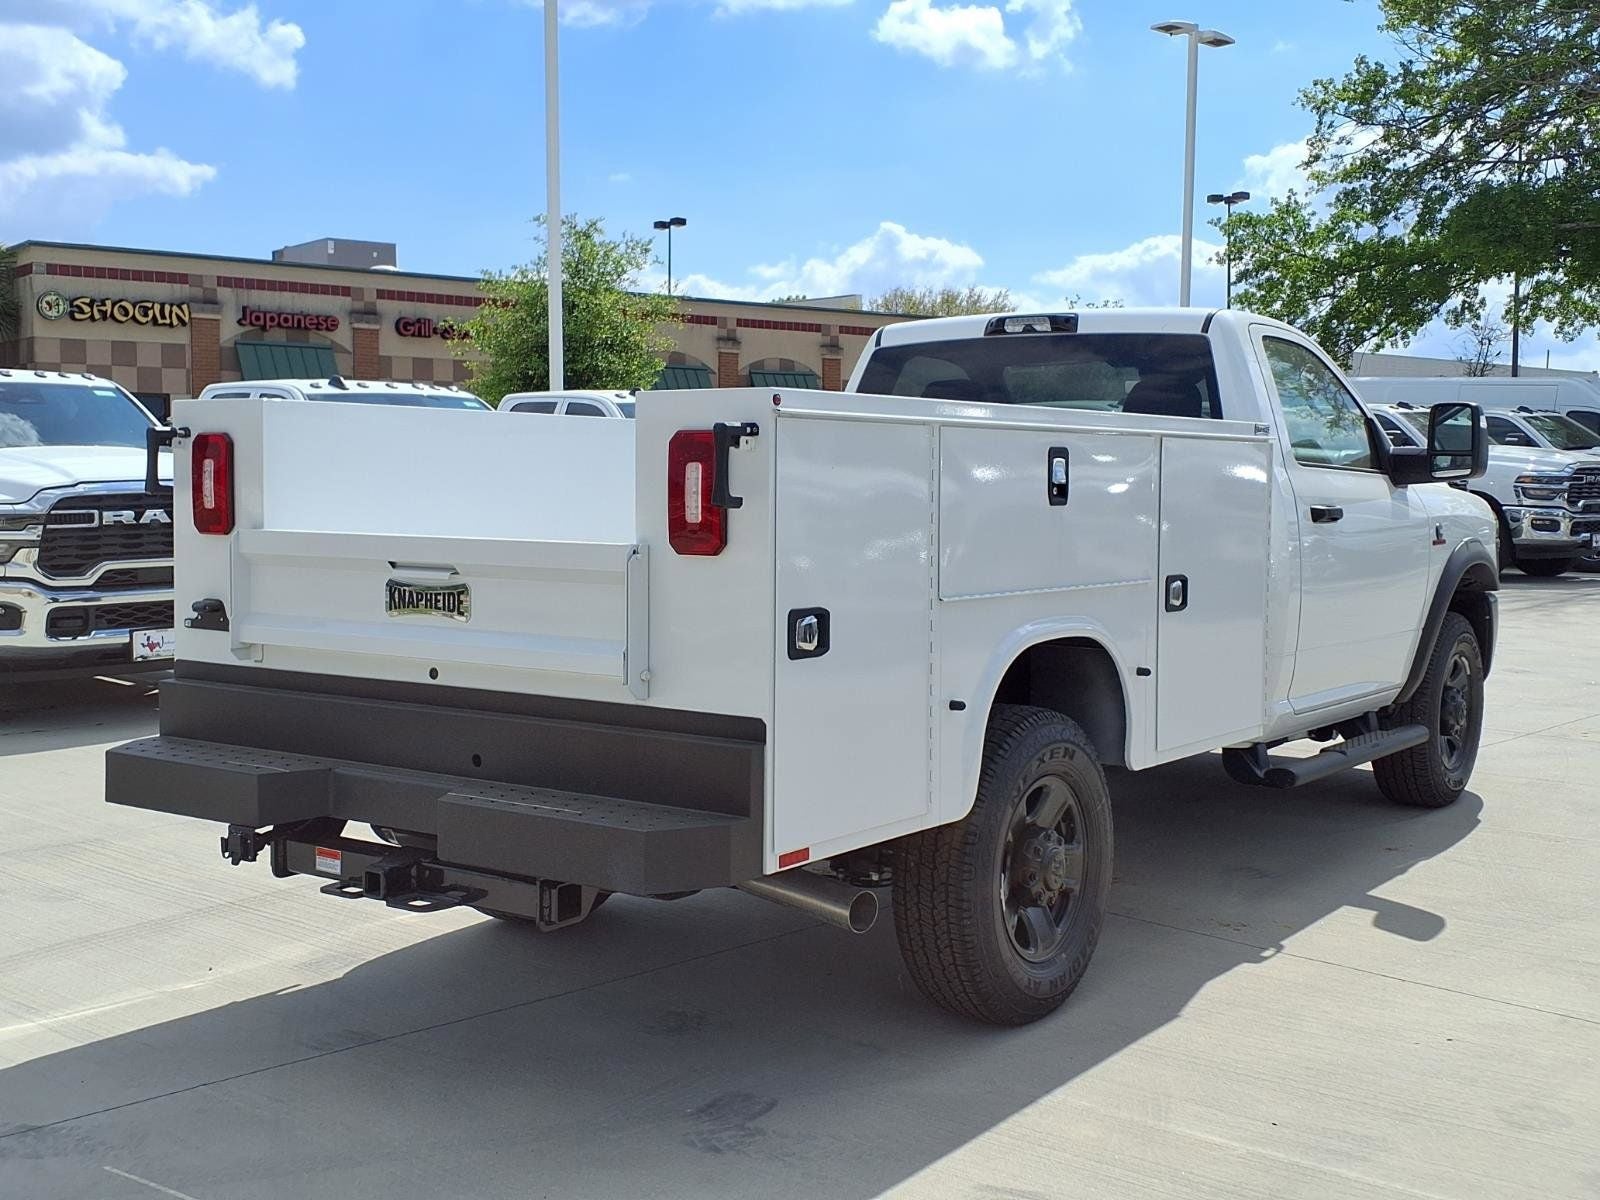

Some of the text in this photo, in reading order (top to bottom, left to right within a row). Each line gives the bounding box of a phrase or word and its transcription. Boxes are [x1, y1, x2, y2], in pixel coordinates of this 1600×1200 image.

[71, 296, 191, 327] SHOGUN
[238, 306, 339, 332] Japanese
[102, 509, 172, 525] RA
[388, 585, 466, 616] KNAPHEIDE
